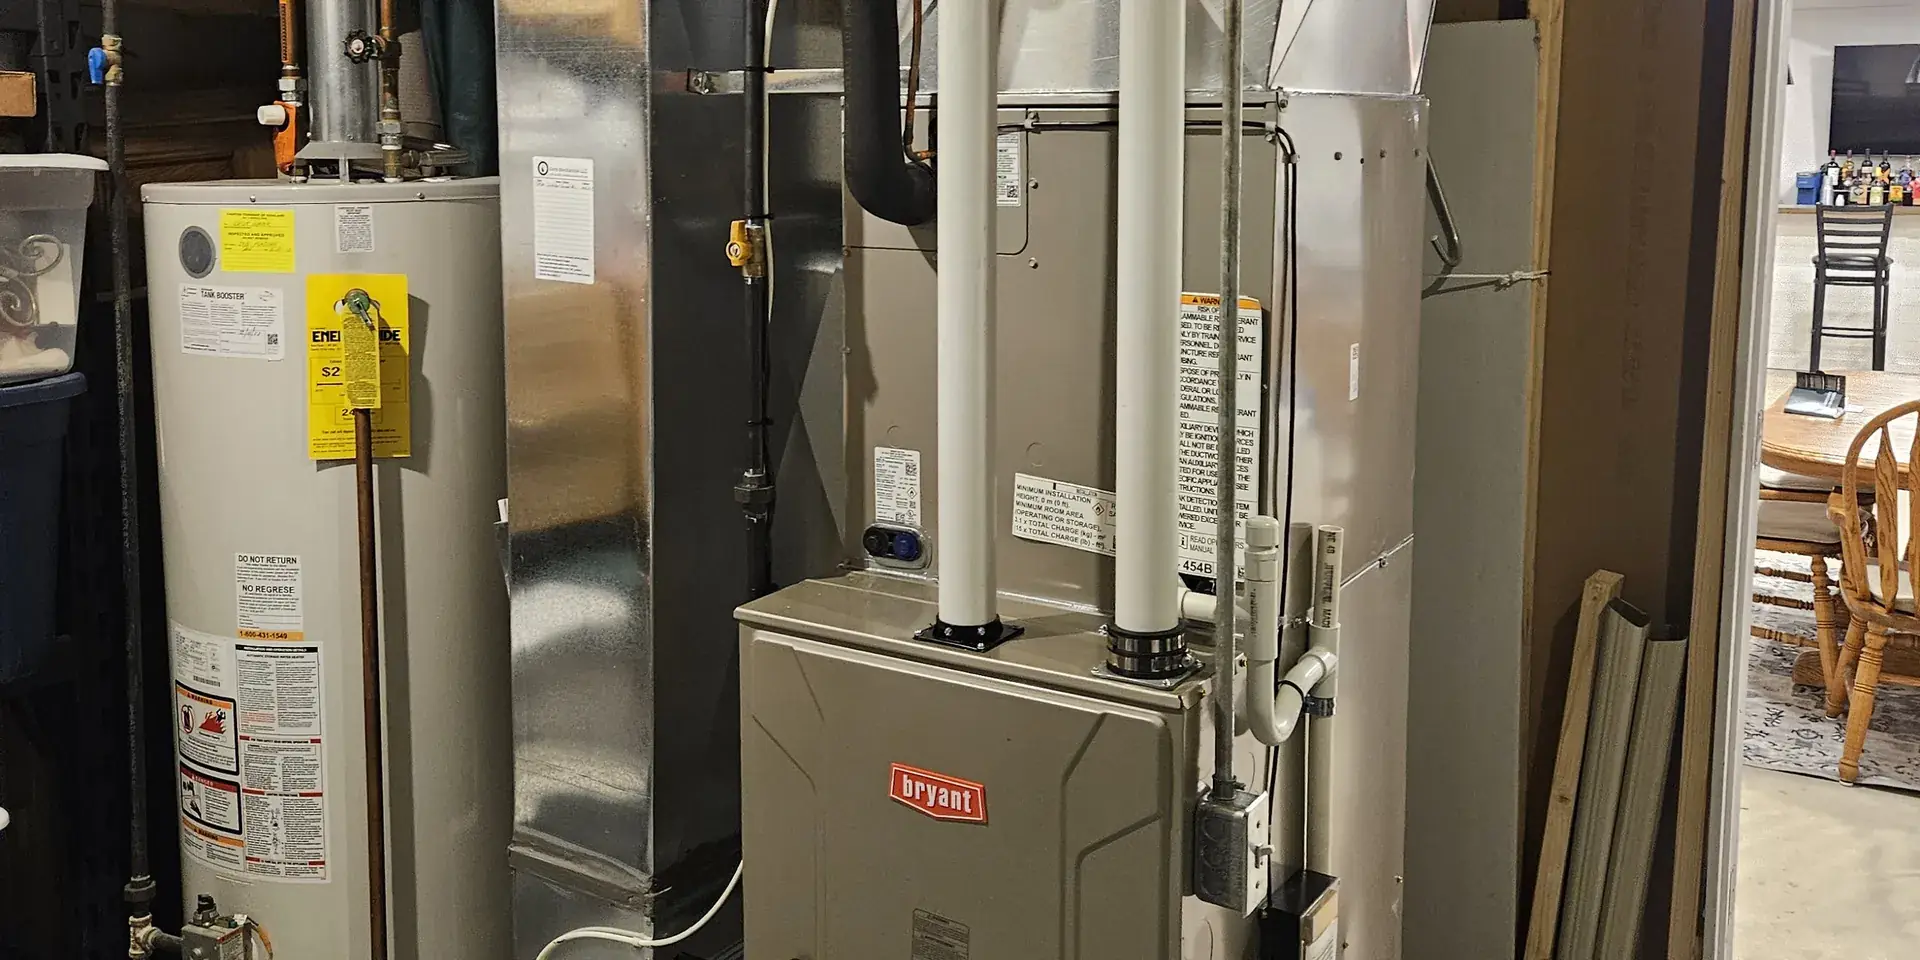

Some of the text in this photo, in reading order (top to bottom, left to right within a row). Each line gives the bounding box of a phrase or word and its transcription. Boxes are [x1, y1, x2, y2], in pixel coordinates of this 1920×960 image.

[216, 292, 245, 300] BOOSTER
[1181, 313, 1213, 321] AMMABLE
[322, 367, 340, 377] $2
[1180, 367, 1200, 375] SPOSE
[1180, 377, 1216, 386] CCORDANCE
[1180, 385, 1200, 393] DERAL
[1180, 394, 1216, 404] GULATIONS.
[1180, 403, 1210, 412] AMMABLE
[1195, 433, 1218, 441] IGNITIO
[1191, 451, 1219, 460] DUCTWO
[1237, 456, 1253, 464] THER
[1188, 459, 1218, 468] AUXILIAR
[1192, 468, 1205, 476] FOR
[1017, 484, 1044, 494] MINIMUM
[1046, 490, 1091, 504] INSTALLATION
[1180, 484, 1215, 495] TRUCTIONS.
[1016, 493, 1040, 502] HEIGHT,
[1187, 496, 1217, 506] DETECTIO
[1016, 500, 1084, 519] MINIMUM ROOM AREA
[1180, 503, 1202, 512] TALLED.
[1015, 509, 1053, 521] (OPERATING
[1201, 515, 1217, 524] EXCE
[1029, 520, 1049, 529] TOTAL
[1051, 524, 1079, 536] CHARGE
[1081, 530, 1092, 538] (kg)
[1029, 528, 1049, 537] TOTAL
[1051, 532, 1078, 544] CHARGE
[1190, 545, 1213, 554] MANUAL
[255, 585, 295, 594] REGRESE
[903, 774, 972, 813] bryant
